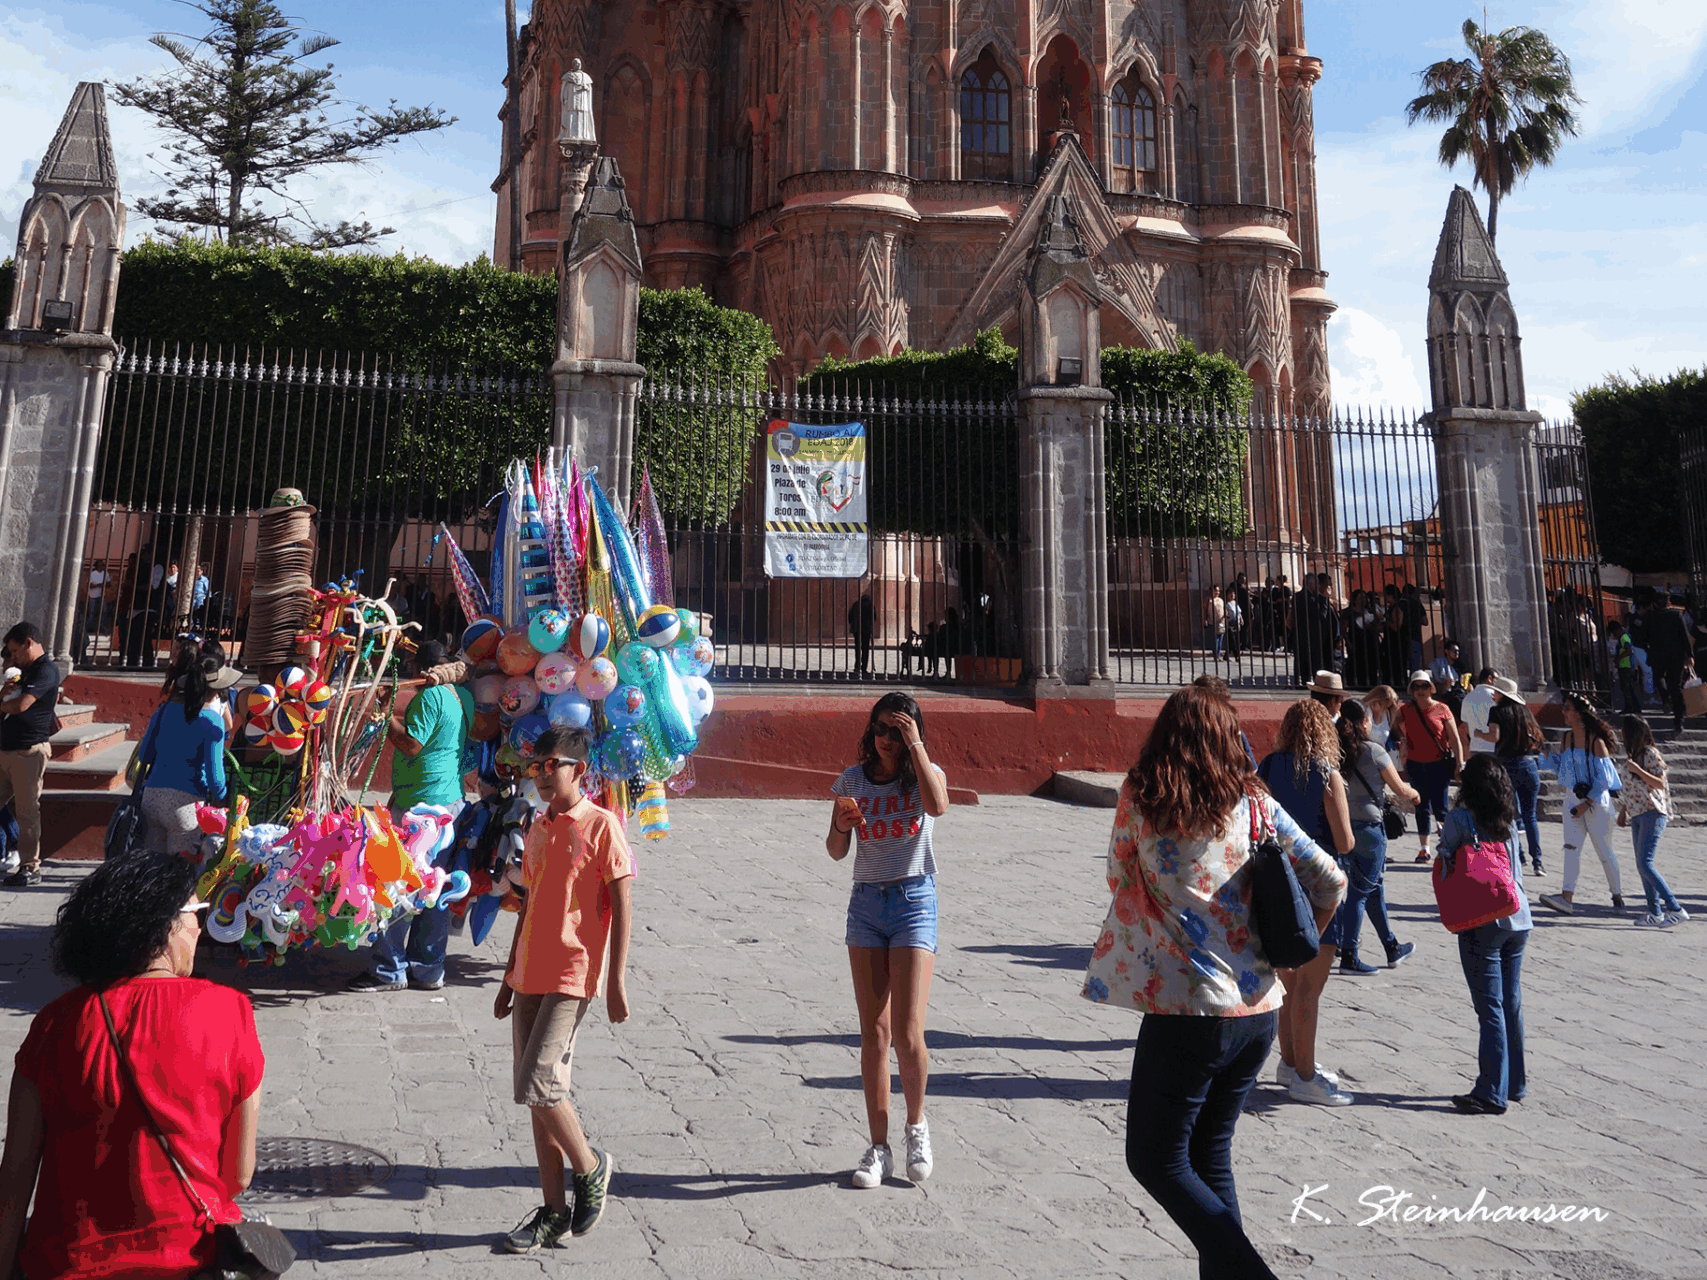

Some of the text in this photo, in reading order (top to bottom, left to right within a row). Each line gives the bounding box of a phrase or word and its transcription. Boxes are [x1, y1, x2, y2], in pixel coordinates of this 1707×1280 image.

[805, 429, 856, 438] RUMBO AL
[771, 464, 780, 473] 29
[793, 465, 810, 474] julio
[774, 478, 794, 488] Plaza
[779, 493, 801, 502] Toros
[774, 507, 806, 516] 8:00 am
[859, 792, 915, 816] GIRL
[859, 816, 919, 840] BOSS
